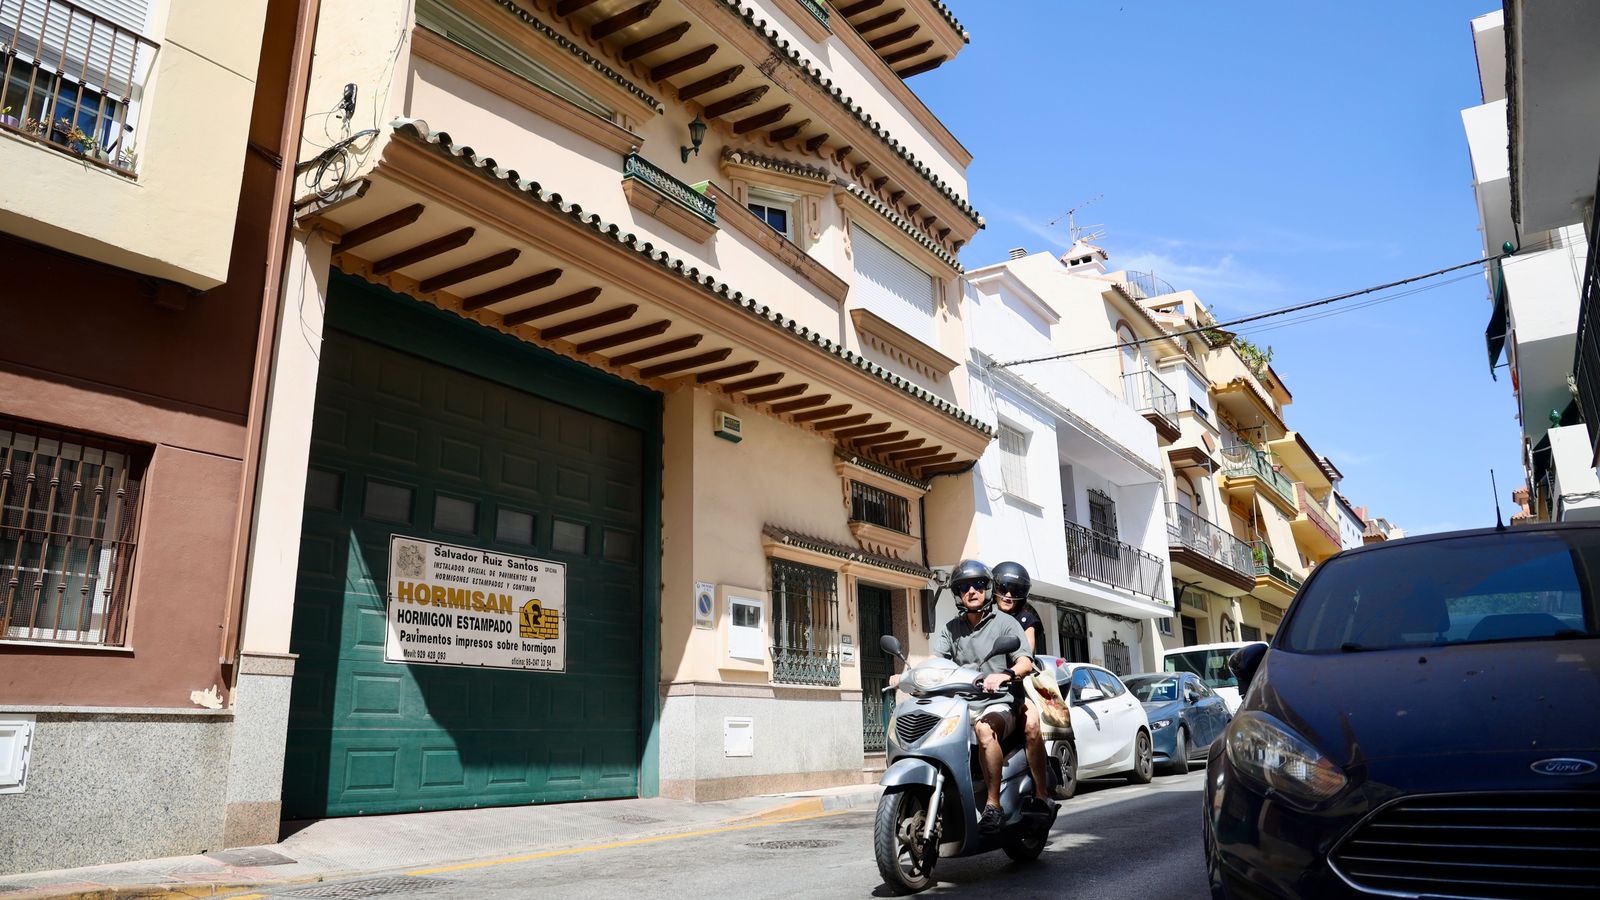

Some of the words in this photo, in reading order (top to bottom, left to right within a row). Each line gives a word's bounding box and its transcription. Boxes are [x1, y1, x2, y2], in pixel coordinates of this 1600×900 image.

[434, 546, 478, 562] Salvador
[482, 555, 502, 566] Ruiz
[507, 559, 539, 572] Santos
[434, 561, 465, 572] INSTALADOR
[468, 567, 486, 576] OFICIAL
[499, 571, 527, 582] PAVIMENTOS
[472, 577, 504, 588] ESTAMPADOS
[512, 583, 536, 592] CONTINUO
[398, 581, 512, 615] HORMISAN
[397, 609, 452, 628] HORMIGON
[457, 615, 512, 634] ESTAMPADO
[400, 629, 452, 645] Pavimentos
[455, 635, 493, 649] impresos
[497, 639, 518, 651] sobre
[522, 641, 556, 655] hormigon
[1545, 762, 1581, 772] Ford
